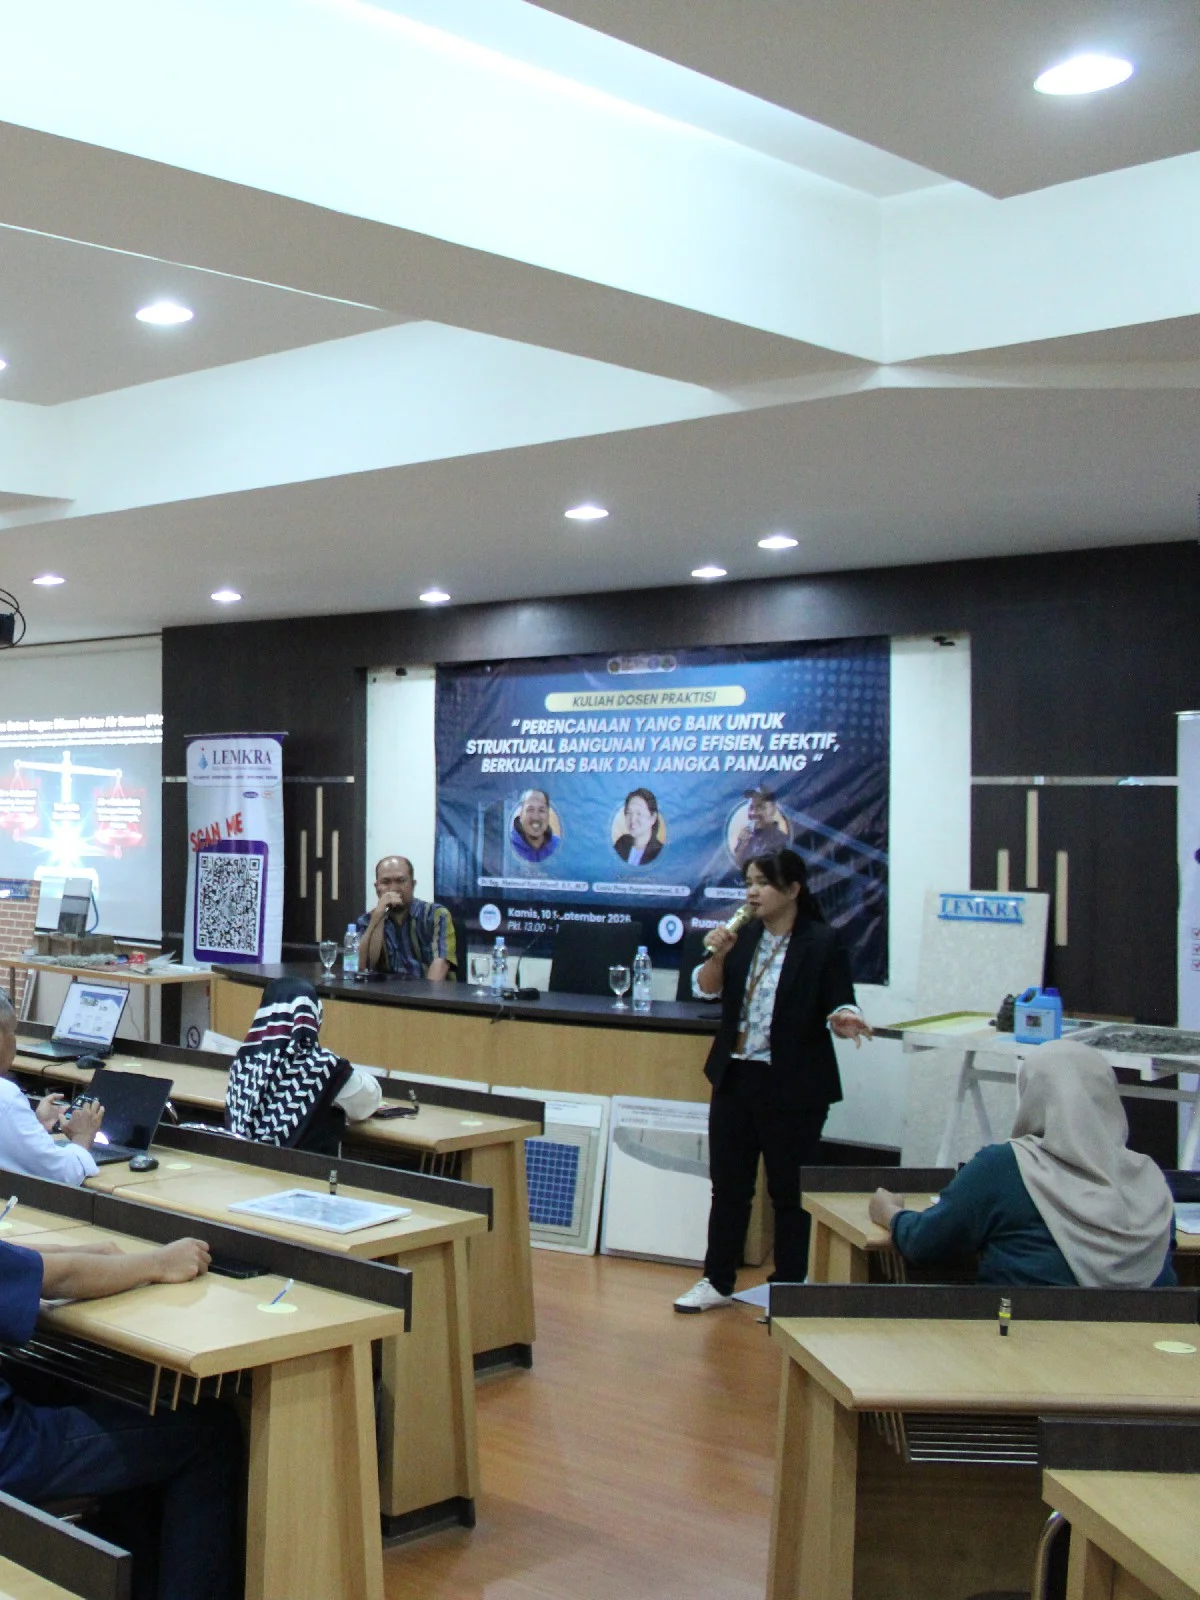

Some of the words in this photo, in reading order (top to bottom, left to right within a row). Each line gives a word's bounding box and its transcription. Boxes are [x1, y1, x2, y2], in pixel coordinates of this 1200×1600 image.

[573, 695, 615, 707] KULIAH
[617, 694, 658, 706] DOSEN
[660, 691, 716, 705] PRAKTISI
[520, 718, 631, 735] PERENCANAAN
[635, 715, 681, 733] YANG
[685, 714, 724, 731] BAIK
[726, 712, 786, 730] UNTUK
[466, 738, 555, 755] STRUKTURAL
[559, 736, 647, 753] BANGUNAN
[650, 735, 697, 751] YANG
[701, 734, 764, 753] EFISIEN,
[769, 732, 840, 753] EFEKTIF,
[213, 750, 272, 765] LEMKRA
[481, 757, 576, 773] BERKUALITAS
[578, 756, 613, 772] BAIK
[616, 755, 651, 772] DAN
[653, 755, 720, 773] JANGKA
[724, 754, 807, 772] PANJANG
[190, 821, 222, 853] SCAN
[225, 811, 244, 838] ME
[507, 907, 540, 920] Kamis,
[942, 899, 1020, 917] LEMKRA
